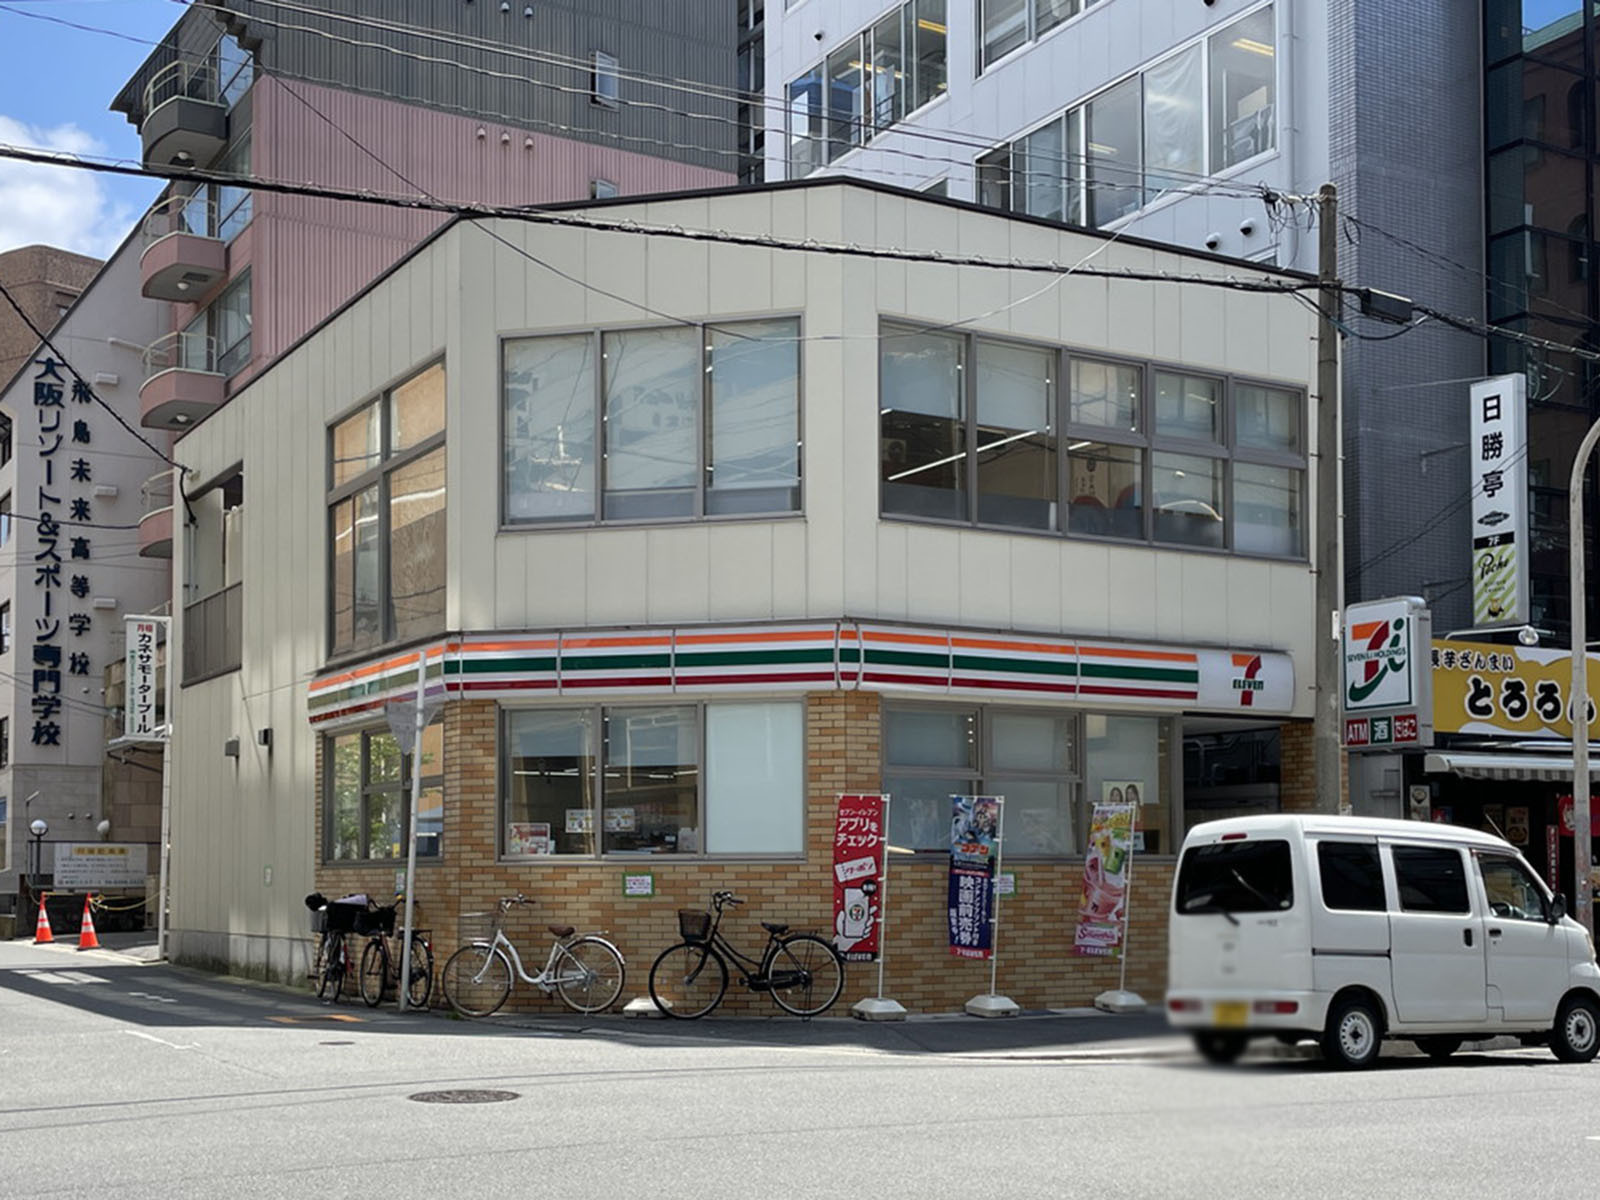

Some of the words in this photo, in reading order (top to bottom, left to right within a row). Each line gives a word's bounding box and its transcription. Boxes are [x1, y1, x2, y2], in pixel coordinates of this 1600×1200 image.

[1482, 394, 1504, 498] 日勝亭
[68, 378, 91, 677] 飛鳥未来高等学校
[1487, 536, 1501, 547] 7F
[1347, 722, 1368, 742] ATM
[1374, 720, 1389, 741] 酒
[1395, 718, 1417, 738] たばこ
[838, 817, 879, 832] アプリを
[836, 833, 878, 847] チェック
[958, 875, 975, 946] 映画前売券
